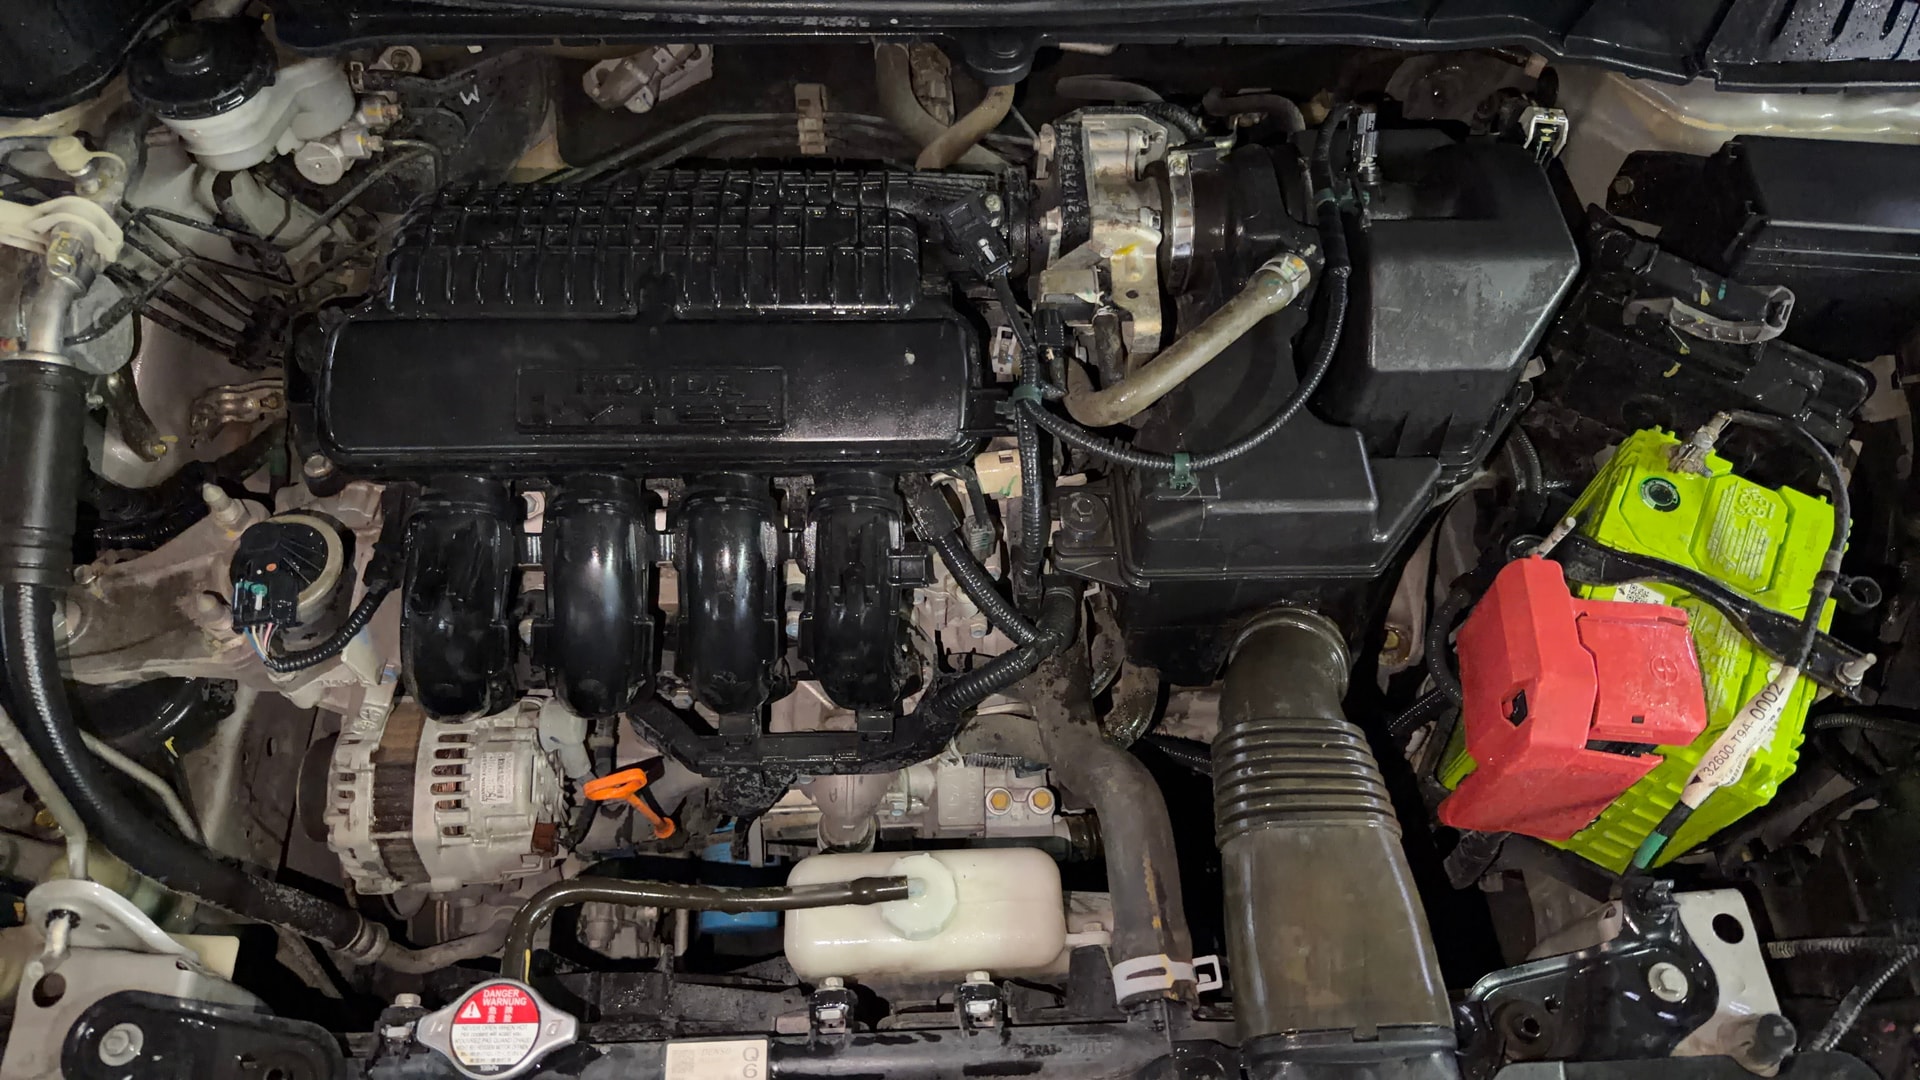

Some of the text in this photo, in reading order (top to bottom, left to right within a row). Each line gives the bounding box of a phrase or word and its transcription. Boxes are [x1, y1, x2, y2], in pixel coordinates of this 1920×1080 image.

[483, 989, 519, 998] DANGER
[482, 997, 527, 1007] WARNUNG
[743, 1047, 760, 1062] Q
[742, 1063, 758, 1079] 6
